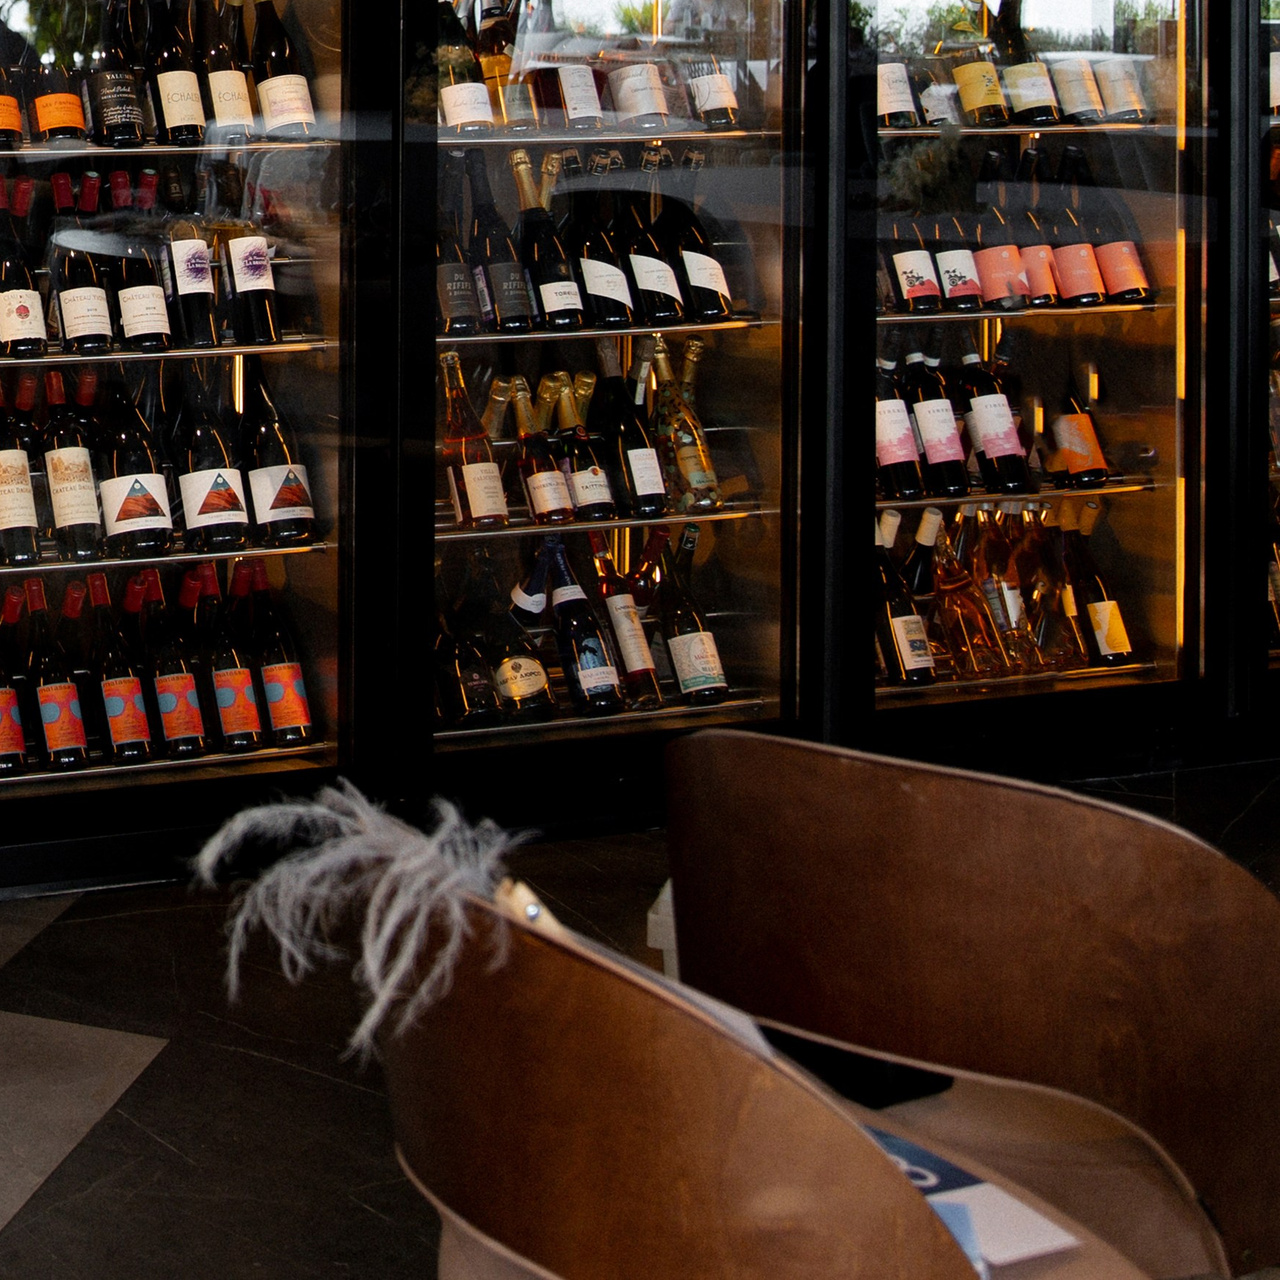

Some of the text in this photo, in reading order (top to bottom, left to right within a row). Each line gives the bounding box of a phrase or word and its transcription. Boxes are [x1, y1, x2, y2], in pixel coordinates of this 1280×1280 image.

[103, 678, 135, 688] matassa
[157, 674, 190, 685] matassa
[38, 684, 72, 694] matassa
